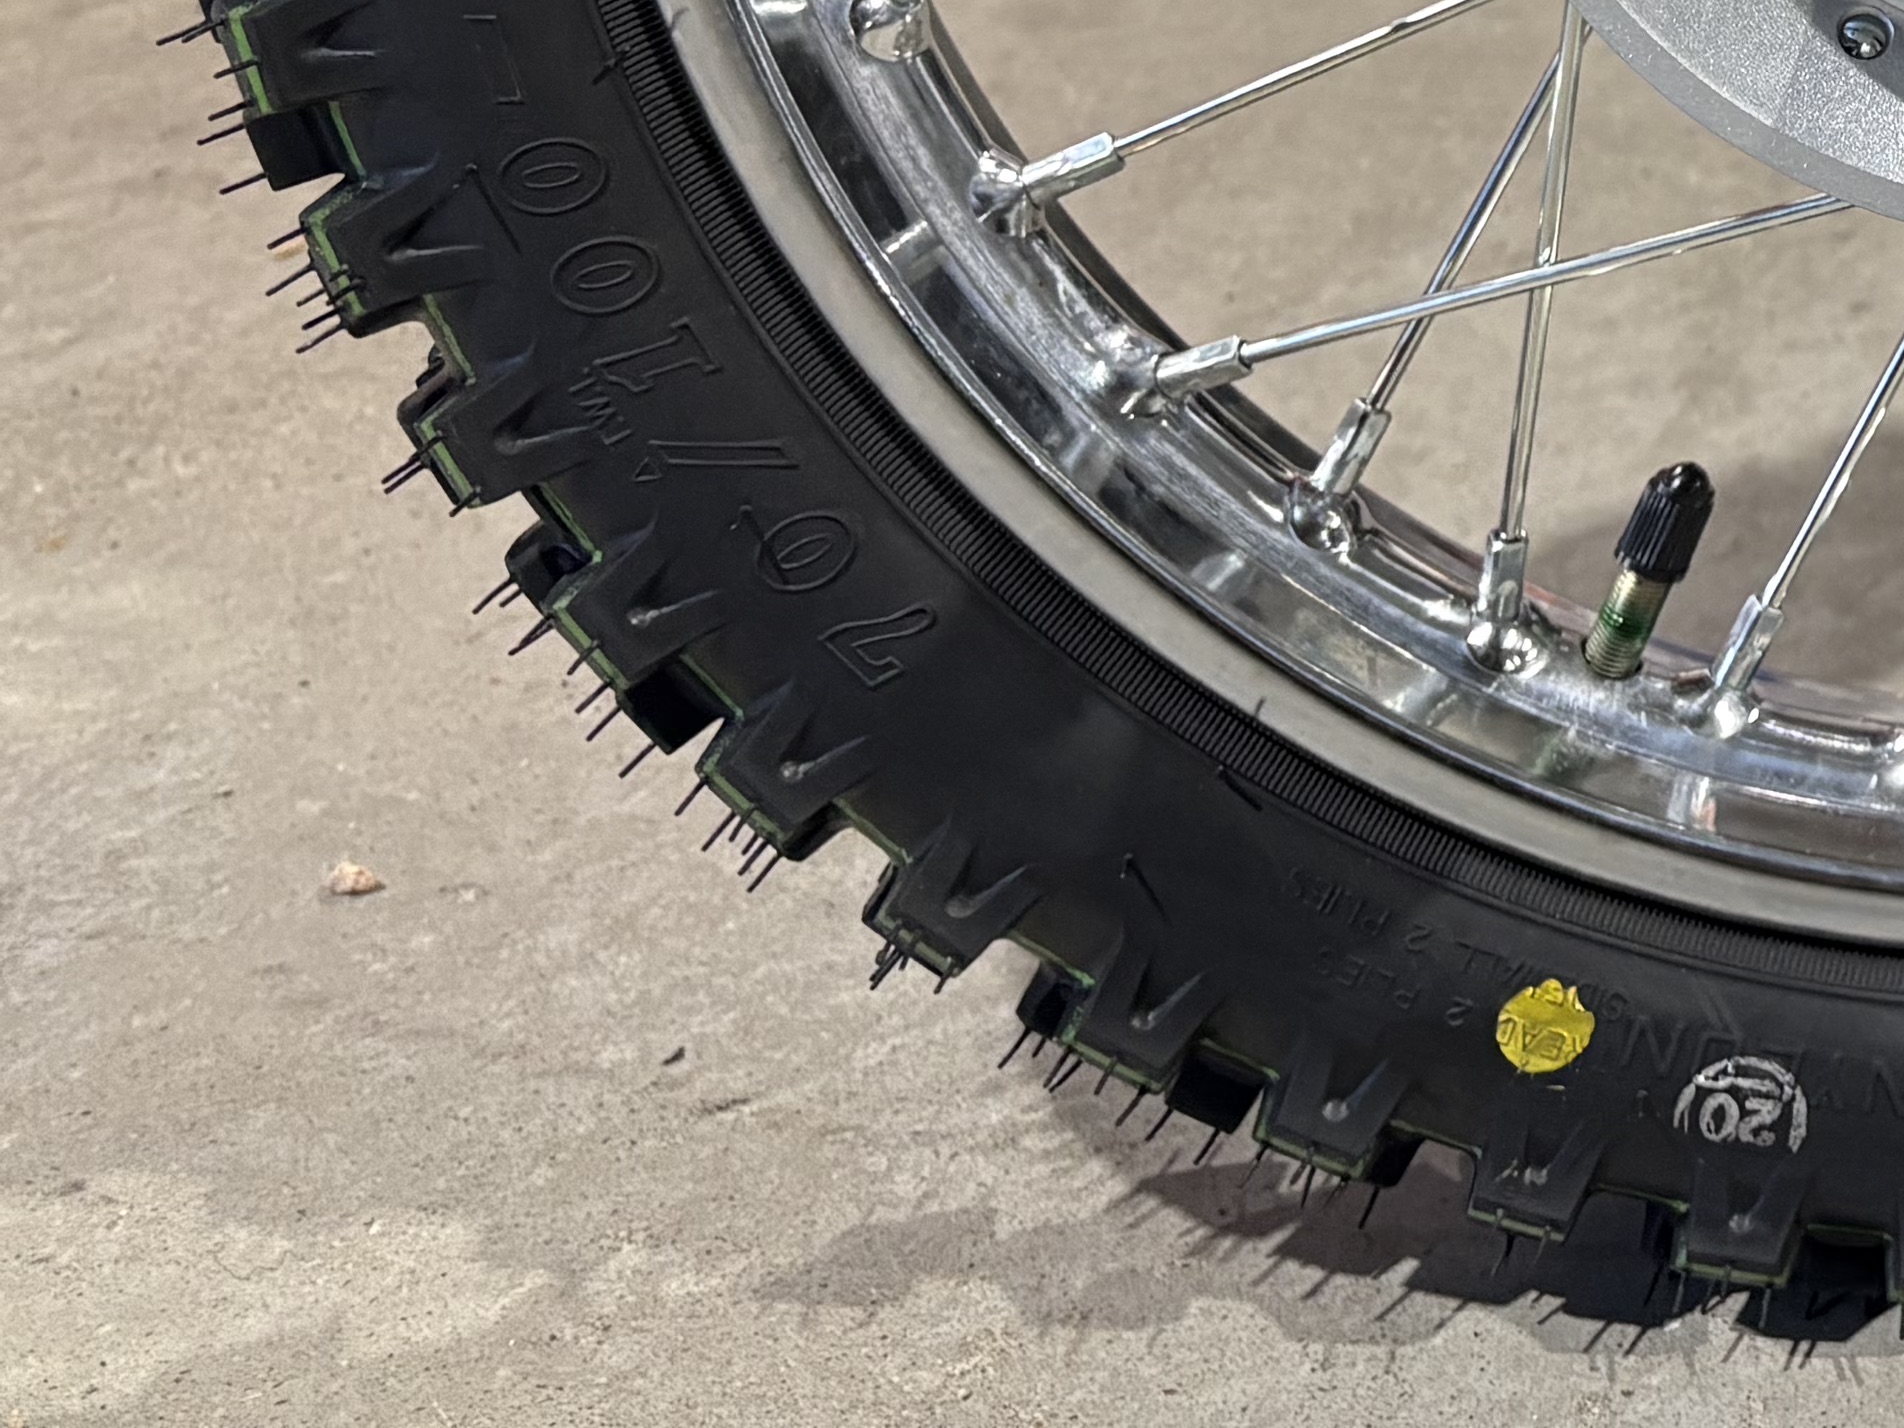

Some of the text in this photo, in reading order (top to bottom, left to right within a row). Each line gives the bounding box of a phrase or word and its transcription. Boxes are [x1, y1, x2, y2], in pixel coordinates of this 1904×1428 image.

[1280, 863, 1393, 939] PLIES
[1403, 922, 1434, 953] 2
[1313, 945, 1609, 1073] READ 2 PLIES
[1699, 1091, 1784, 1147] 20
